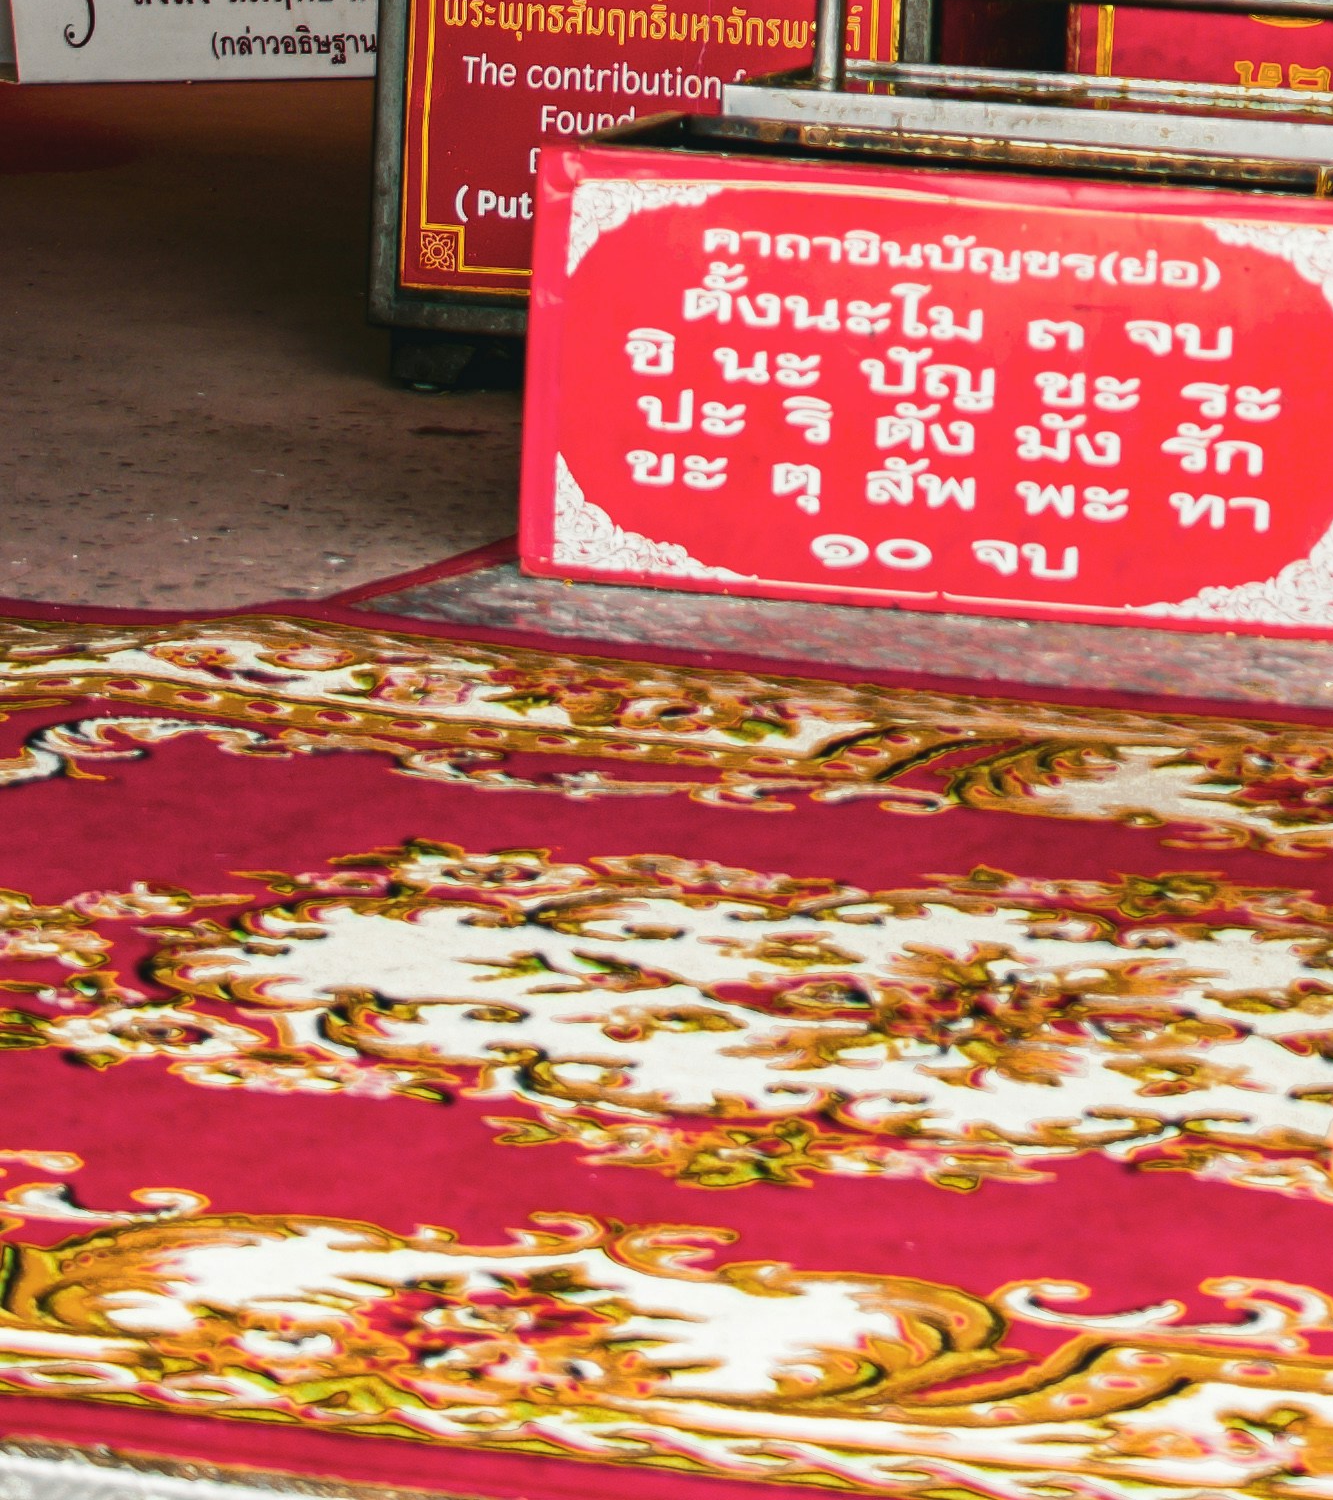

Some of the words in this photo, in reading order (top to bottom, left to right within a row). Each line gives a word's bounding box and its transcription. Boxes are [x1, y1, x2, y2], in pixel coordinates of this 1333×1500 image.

[462, 52, 517, 87] The
[526, 62, 723, 101] contribution
[477, 189, 533, 220] Put
[682, 261, 984, 344] ตั้งนะโม
[1124, 319, 1234, 362] จบ
[712, 346, 822, 388] นะ
[859, 345, 996, 412] ปัญ
[1179, 381, 1283, 422] ระ
[636, 387, 748, 437] ปะ
[781, 394, 834, 445] ริ
[874, 401, 976, 457] ตัง
[1014, 411, 1122, 468] มัง
[1159, 421, 1264, 478] รัก
[770, 461, 822, 515] ตุ
[865, 455, 977, 513] สัพ
[1014, 479, 1130, 522] พะ
[1167, 491, 1271, 533] ทา
[808, 532, 933, 570] ๑๐
[970, 538, 1080, 581] จบ
